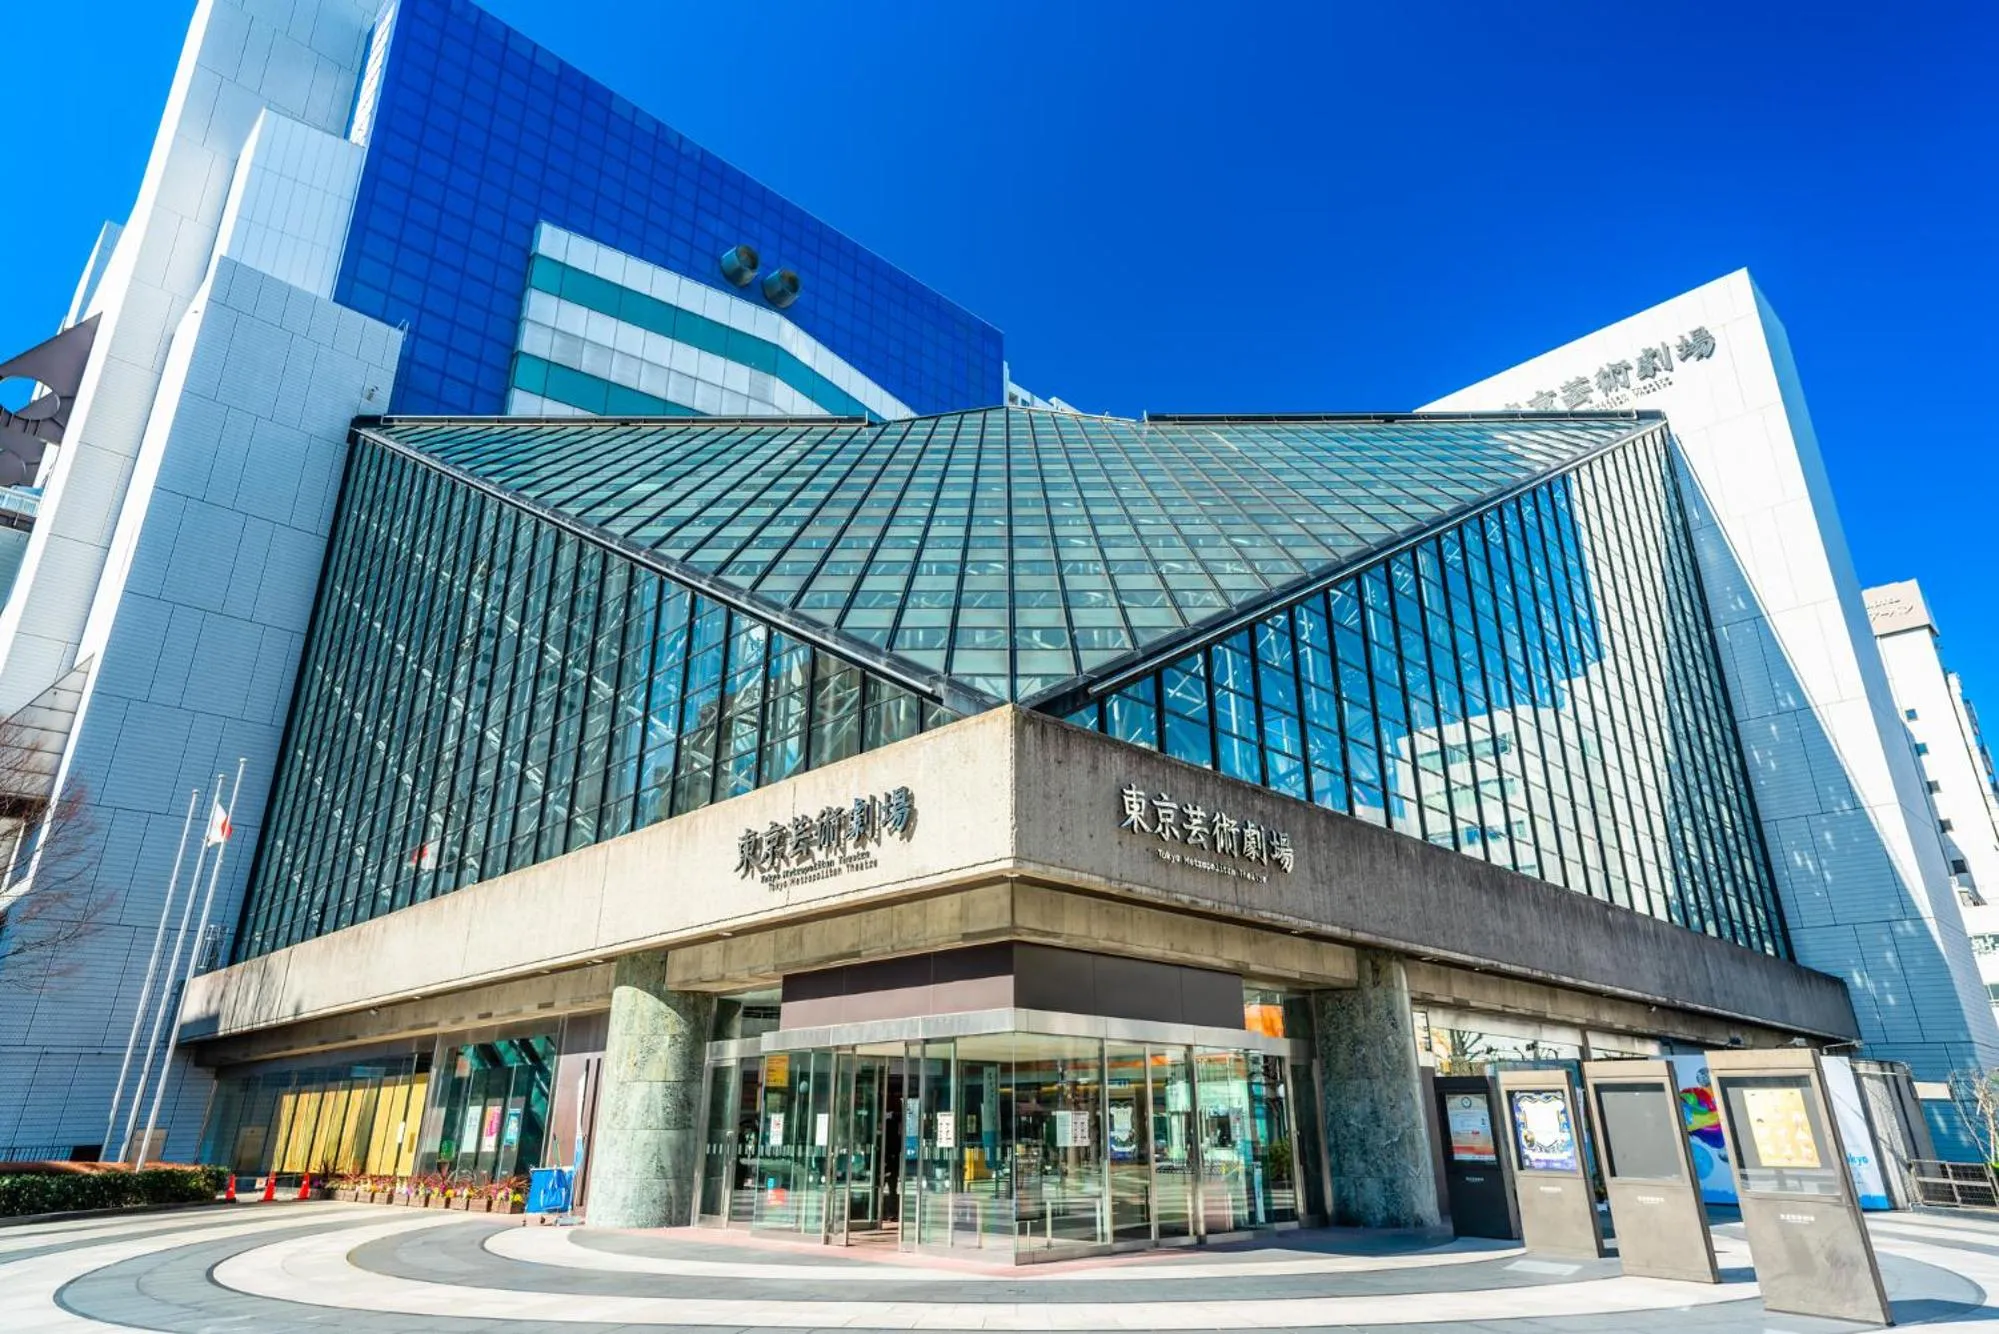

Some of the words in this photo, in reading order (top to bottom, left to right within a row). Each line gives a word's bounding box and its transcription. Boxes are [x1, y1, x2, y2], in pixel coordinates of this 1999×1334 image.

[734, 785, 913, 879] 東京芸術劇場
[1119, 783, 1295, 874] 東京芸術劇場
